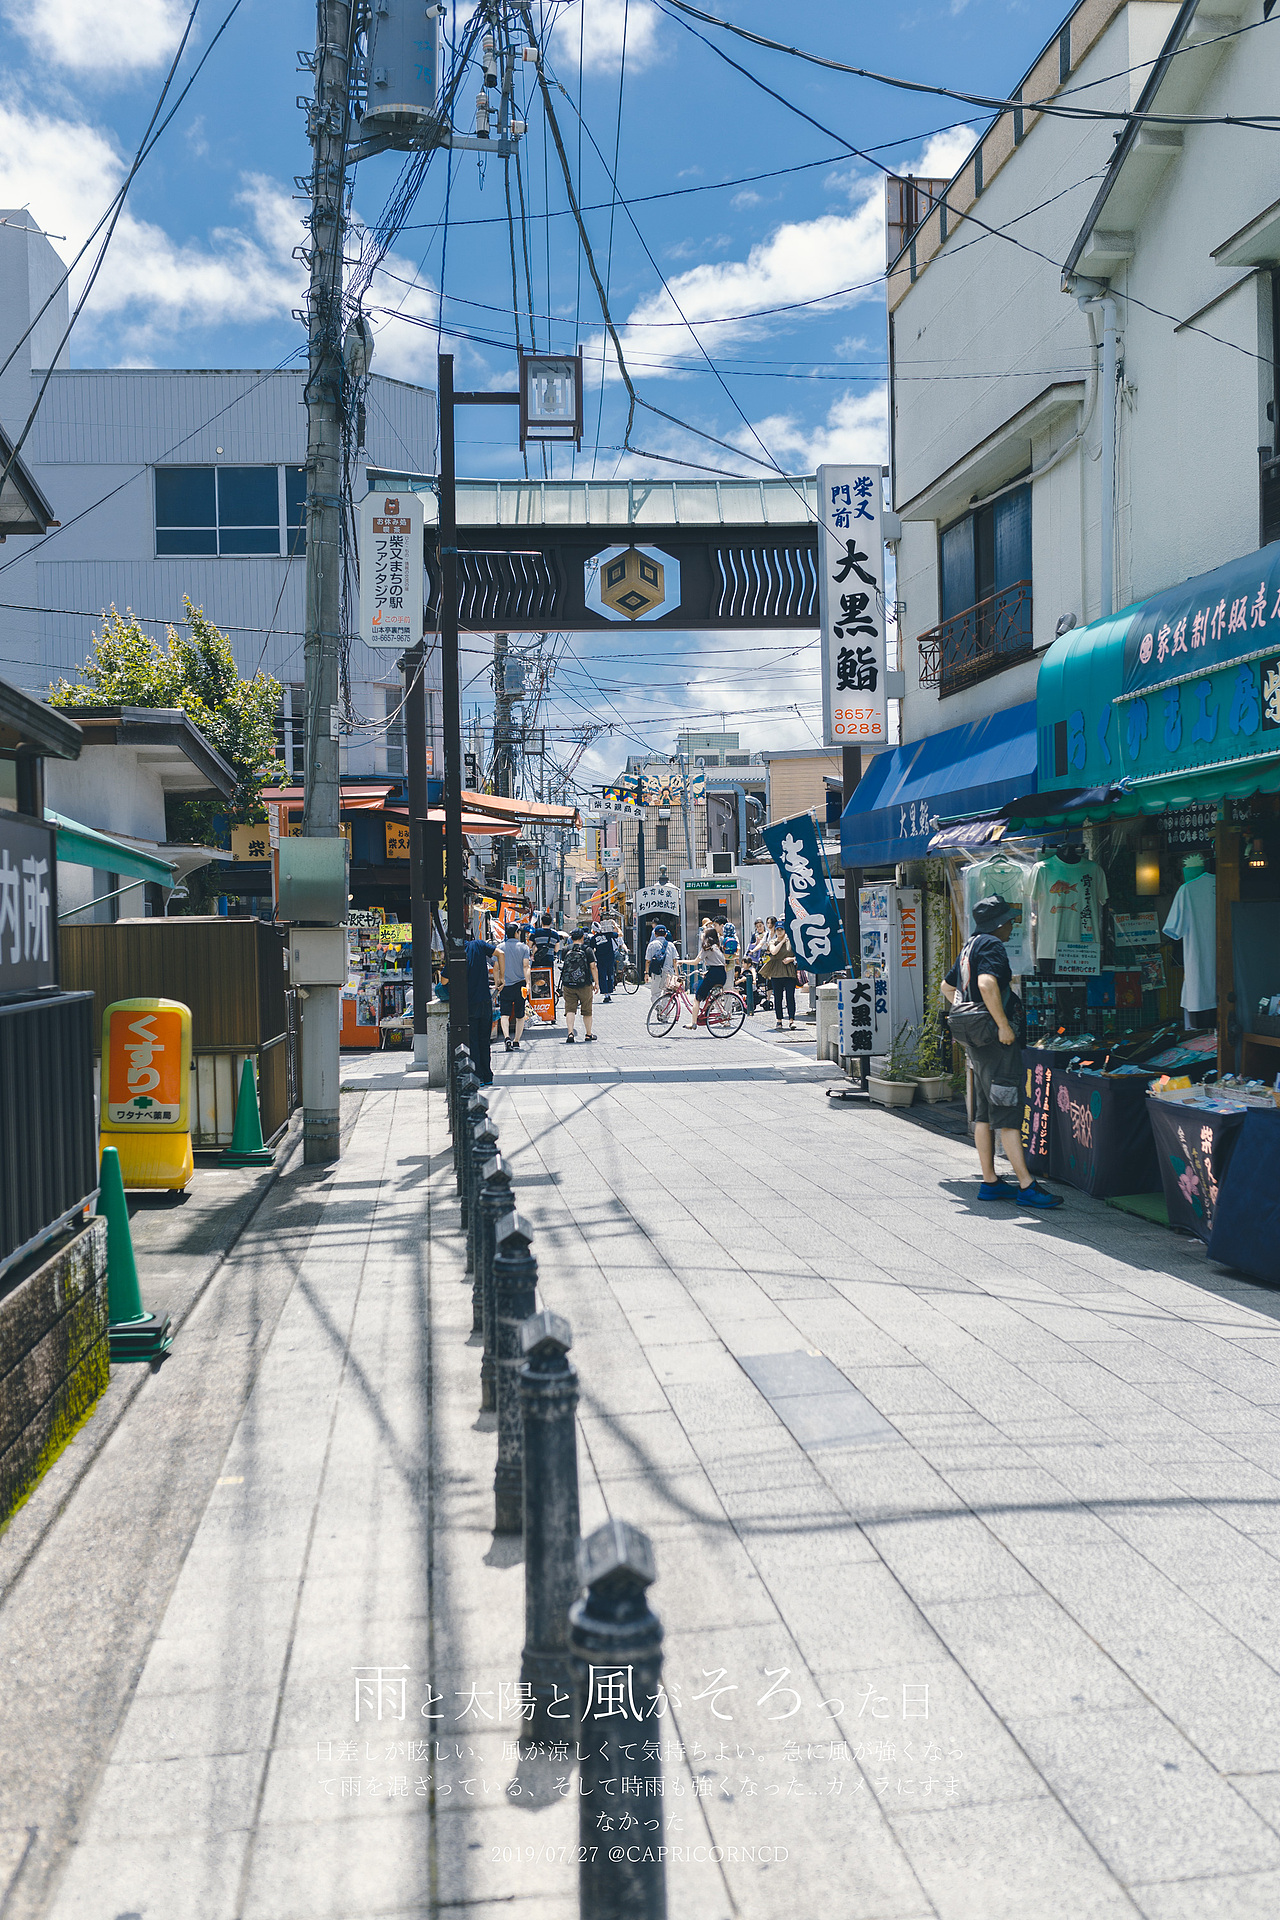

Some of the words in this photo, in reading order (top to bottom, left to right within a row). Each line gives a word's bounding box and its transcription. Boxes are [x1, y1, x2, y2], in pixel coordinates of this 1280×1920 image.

[831, 484, 852, 529] 門前
[853, 476, 875, 521] 柴又
[376, 518, 407, 526] お休み処
[375, 540, 388, 609] ファンタジア
[389, 535, 404, 609] 柴又まちの駅
[384, 615, 411, 624] この手前
[832, 538, 879, 693] 大黒鮨
[371, 626, 411, 634] 山本亭裏門隣
[371, 634, 411, 643] 03-6657-9675
[834, 708, 882, 720] 3657-
[834, 723, 882, 735] 0288
[388, 838, 410, 850] 柴又
[901, 908, 917, 968] KIRIN
[533, 1003, 550, 1011] UCC
[875, 980, 888, 1014] 柴又
[849, 981, 873, 1052] 大黒鮨
[124, 1014, 165, 1094] くすり
[117, 1109, 172, 1121] ワタナベ薬局
